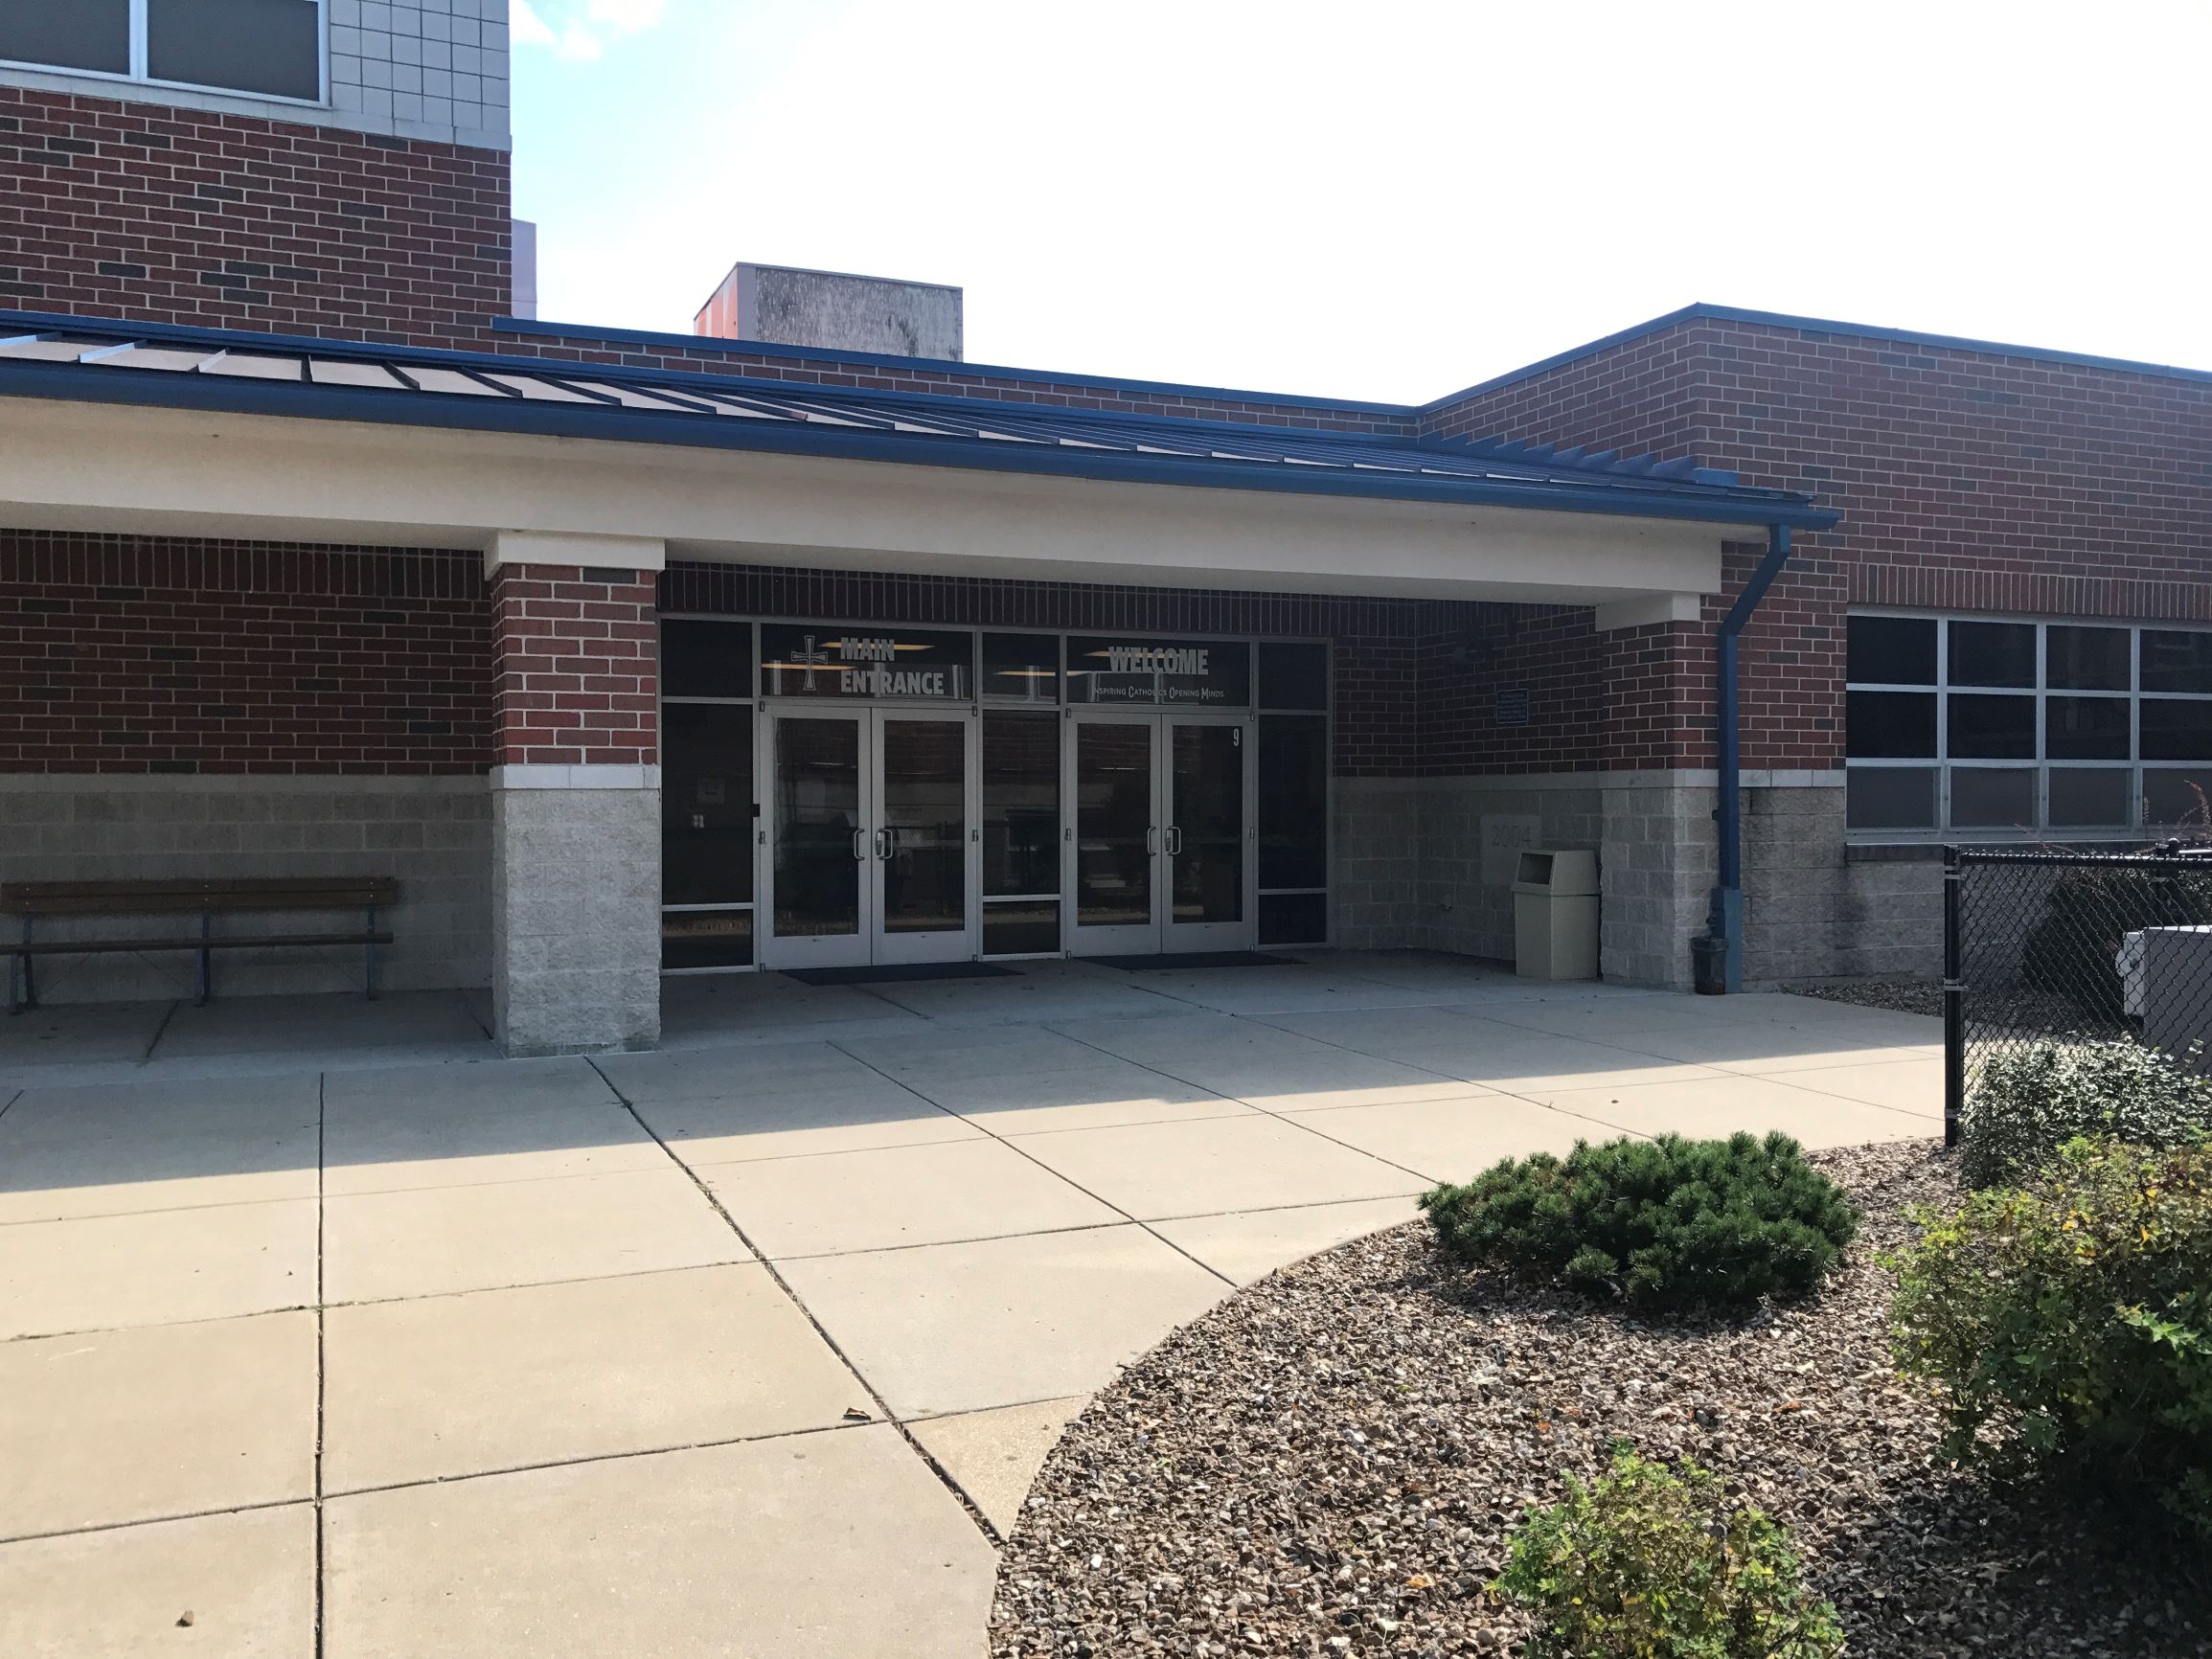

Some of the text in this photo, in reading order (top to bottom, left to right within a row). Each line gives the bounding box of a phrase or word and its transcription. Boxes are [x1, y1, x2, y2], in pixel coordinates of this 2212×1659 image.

[840, 637, 895, 662] MAIN
[1108, 647, 1208, 675] WELCOME
[841, 671, 945, 694] ENTRANCE
[1092, 686, 1127, 696] NSPIRING
[1233, 728, 1240, 746] 9
[1492, 826, 1533, 847] 2004
